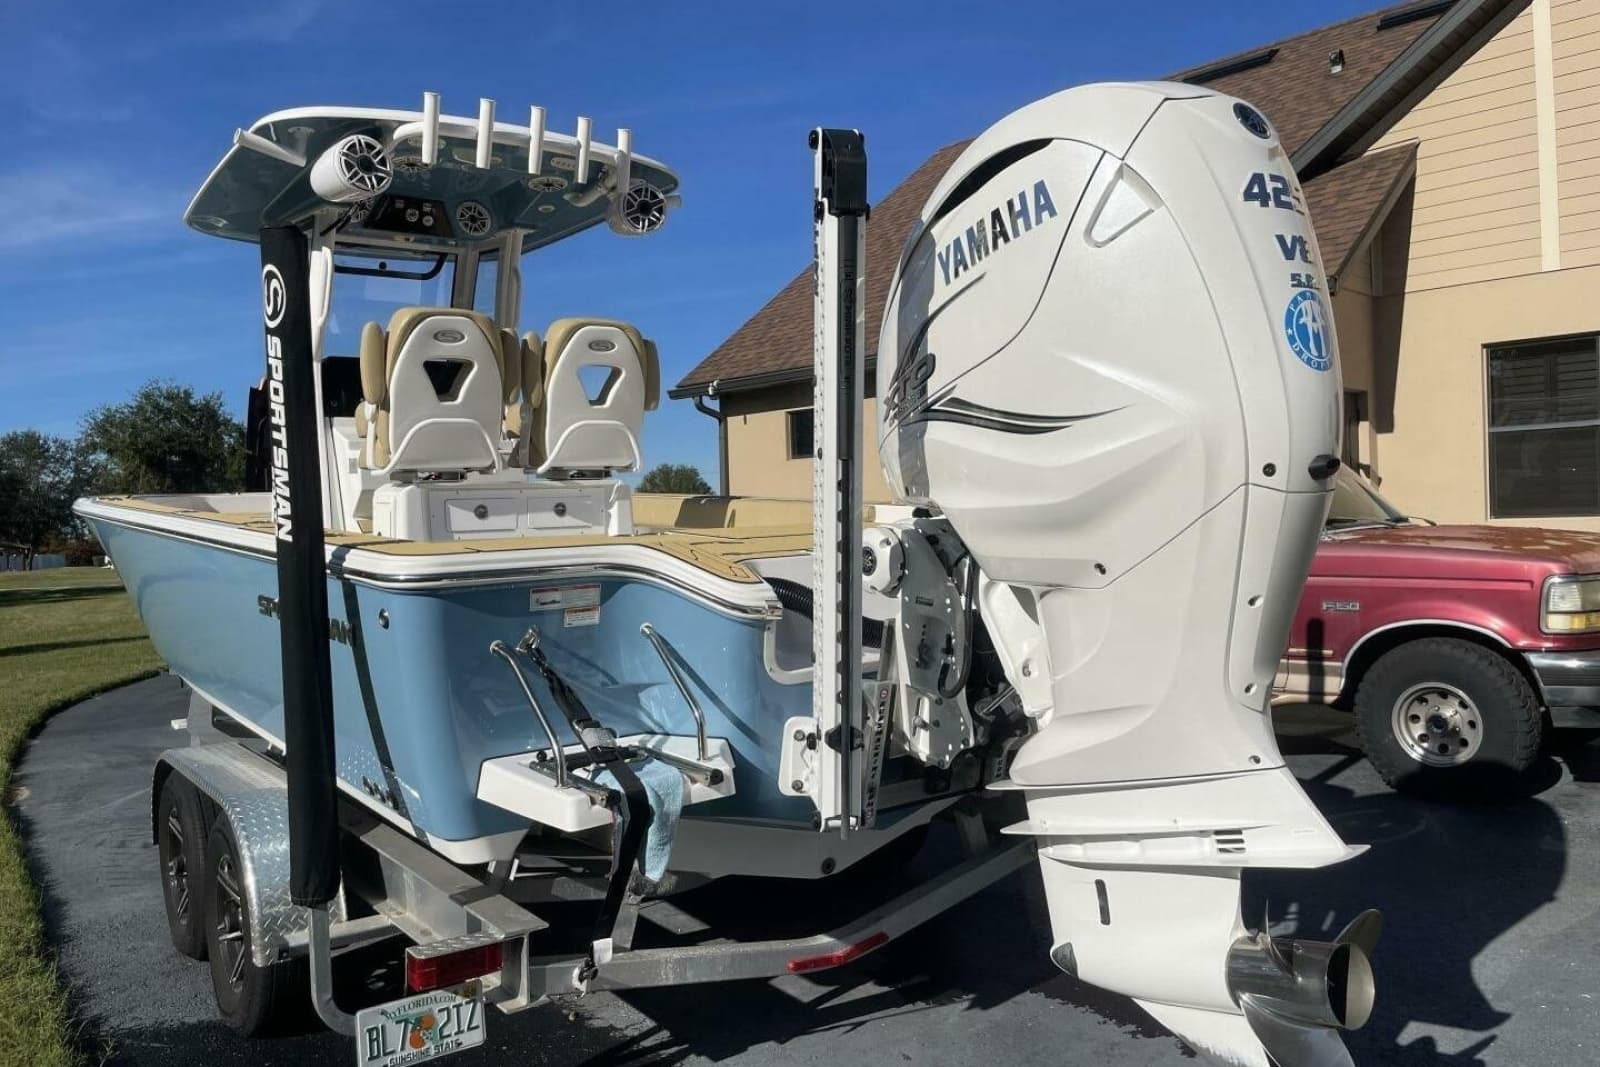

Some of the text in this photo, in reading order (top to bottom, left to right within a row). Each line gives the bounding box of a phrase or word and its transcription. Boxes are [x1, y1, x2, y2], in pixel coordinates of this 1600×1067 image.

[937, 179, 1057, 287] YAMAHA
[884, 352, 936, 423] XTO
[267, 335, 293, 543] SPORTSMAN
[365, 1018, 409, 1061] BL7
